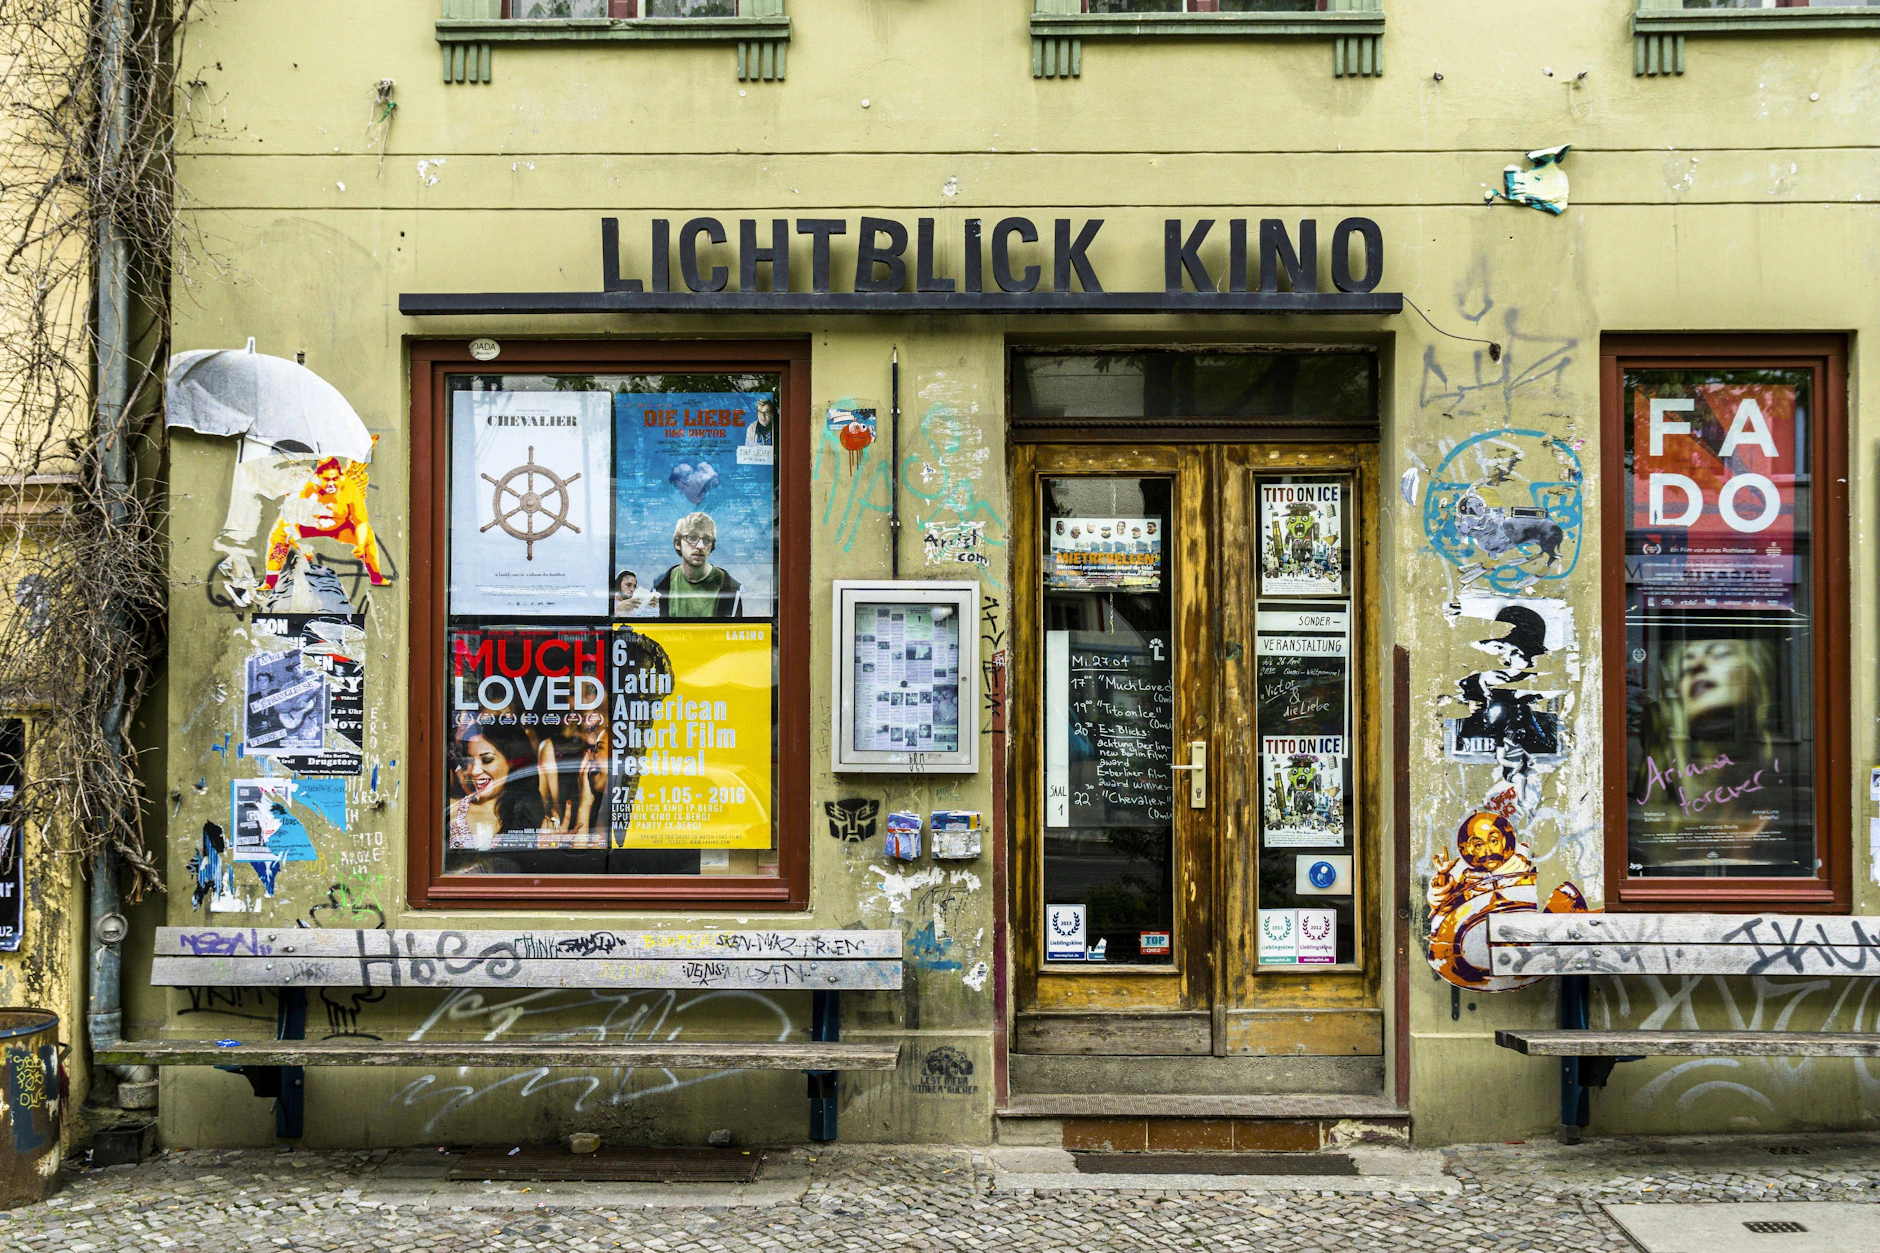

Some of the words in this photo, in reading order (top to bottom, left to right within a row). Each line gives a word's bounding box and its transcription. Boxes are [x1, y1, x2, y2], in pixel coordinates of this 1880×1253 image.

[602, 216, 1105, 294] LICHTBLICK
[1164, 217, 1384, 294] KINO
[487, 415, 577, 427] CHEVALIER
[643, 409, 678, 427] DIE
[683, 409, 746, 427] LIEBE
[664, 428, 685, 438] UND
[688, 428, 727, 438] VIKTOR
[1263, 487, 1294, 502] TITO
[1297, 487, 1314, 502] ON
[1317, 486, 1339, 501] ICE
[1055, 552, 1155, 565] MIETREBELLEN
[725, 630, 765, 641] LAKINO
[1263, 638, 1342, 652] VERANSTALTUNG
[454, 639, 605, 678] MUCH
[612, 639, 636, 667] 6.
[612, 667, 672, 694] Latin
[454, 675, 605, 711] LOVED
[1289, 687, 1301, 704] &
[612, 694, 727, 721] American
[1300, 697, 1330, 715] Liebe
[612, 721, 679, 749] Short
[686, 721, 737, 749] Film
[1265, 739, 1296, 754] TITO
[1299, 738, 1317, 754] ON
[1319, 738, 1341, 753] ICE
[307, 757, 358, 767] Drugstore
[612, 749, 705, 776] Festival
[1099, 758, 1130, 767] award
[1097, 778, 1129, 788] award
[611, 786, 645, 804] 27.4
[659, 786, 692, 804] 1.05
[709, 786, 746, 804] 2016
[611, 803, 660, 813] LICHTBLICK
[663, 803, 683, 813] KINO
[611, 812, 648, 821] SPUTNIK
[650, 812, 670, 821] KINO
[611, 821, 632, 830] MAZE
[636, 821, 661, 830] PARTY
[1144, 935, 1165, 946] TOP
[1261, 944, 1295, 952] Lieblingskino
[1299, 944, 1333, 952] Lieblingskino
